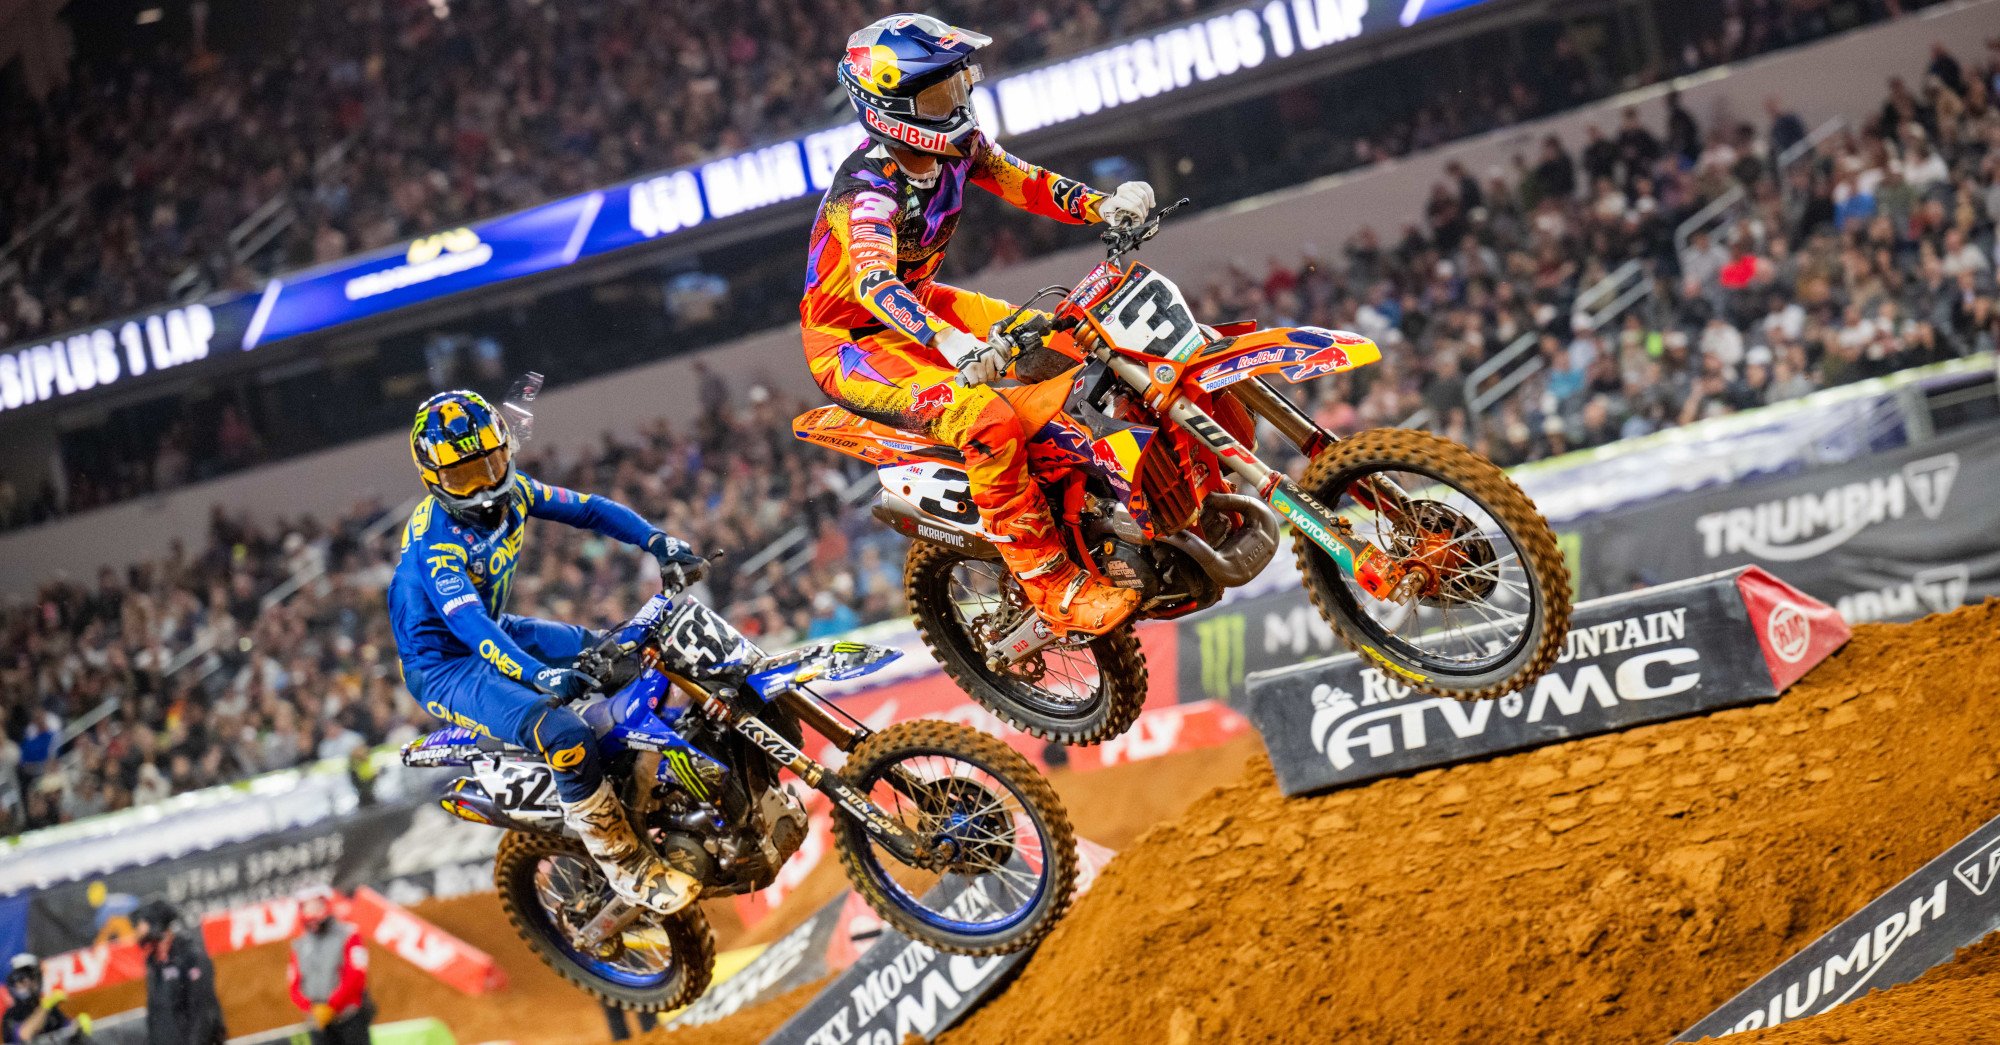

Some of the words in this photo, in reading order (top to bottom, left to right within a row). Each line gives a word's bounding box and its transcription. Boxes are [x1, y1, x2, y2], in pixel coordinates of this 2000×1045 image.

[1262, 0, 1293, 57] 1
[866, 106, 904, 140] Red
[905, 127, 947, 152] Bull
[852, 190, 898, 222] 3
[882, 294, 906, 320] Red
[898, 310, 925, 333] Bull
[1118, 280, 1194, 358] 3
[0, 330, 119, 411] S/PLUS
[121, 322, 146, 376] 1
[146, 305, 214, 370] LAP
[1206, 372, 1242, 390] PROGRESSIVE
[1237, 354, 1260, 369] Red
[1258, 349, 1285, 364] Bull
[817, 434, 858, 448] DUNLOP
[920, 468, 983, 524] 3
[1695, 474, 1905, 560] TRIUMPH
[489, 522, 524, 575] ONE
[666, 536, 680, 557] ONE
[1289, 509, 1346, 556] MOTOREX
[479, 639, 523, 680] ONEA
[1013, 639, 1029, 653] DID
[1566, 608, 1687, 666] UNTAIN
[1527, 647, 1702, 723] MC
[427, 701, 493, 739] ONEA
[735, 717, 800, 765] KYB
[1325, 697, 1497, 770] ATV
[410, 748, 452, 761] DUNLOP
[495, 767, 552, 811] 32
[167, 862, 239, 902] UTAH
[230, 895, 299, 950] FLY
[374, 909, 458, 971] FLY
[41, 945, 108, 996] FLY
[1717, 879, 1948, 1037] RIUMPH
